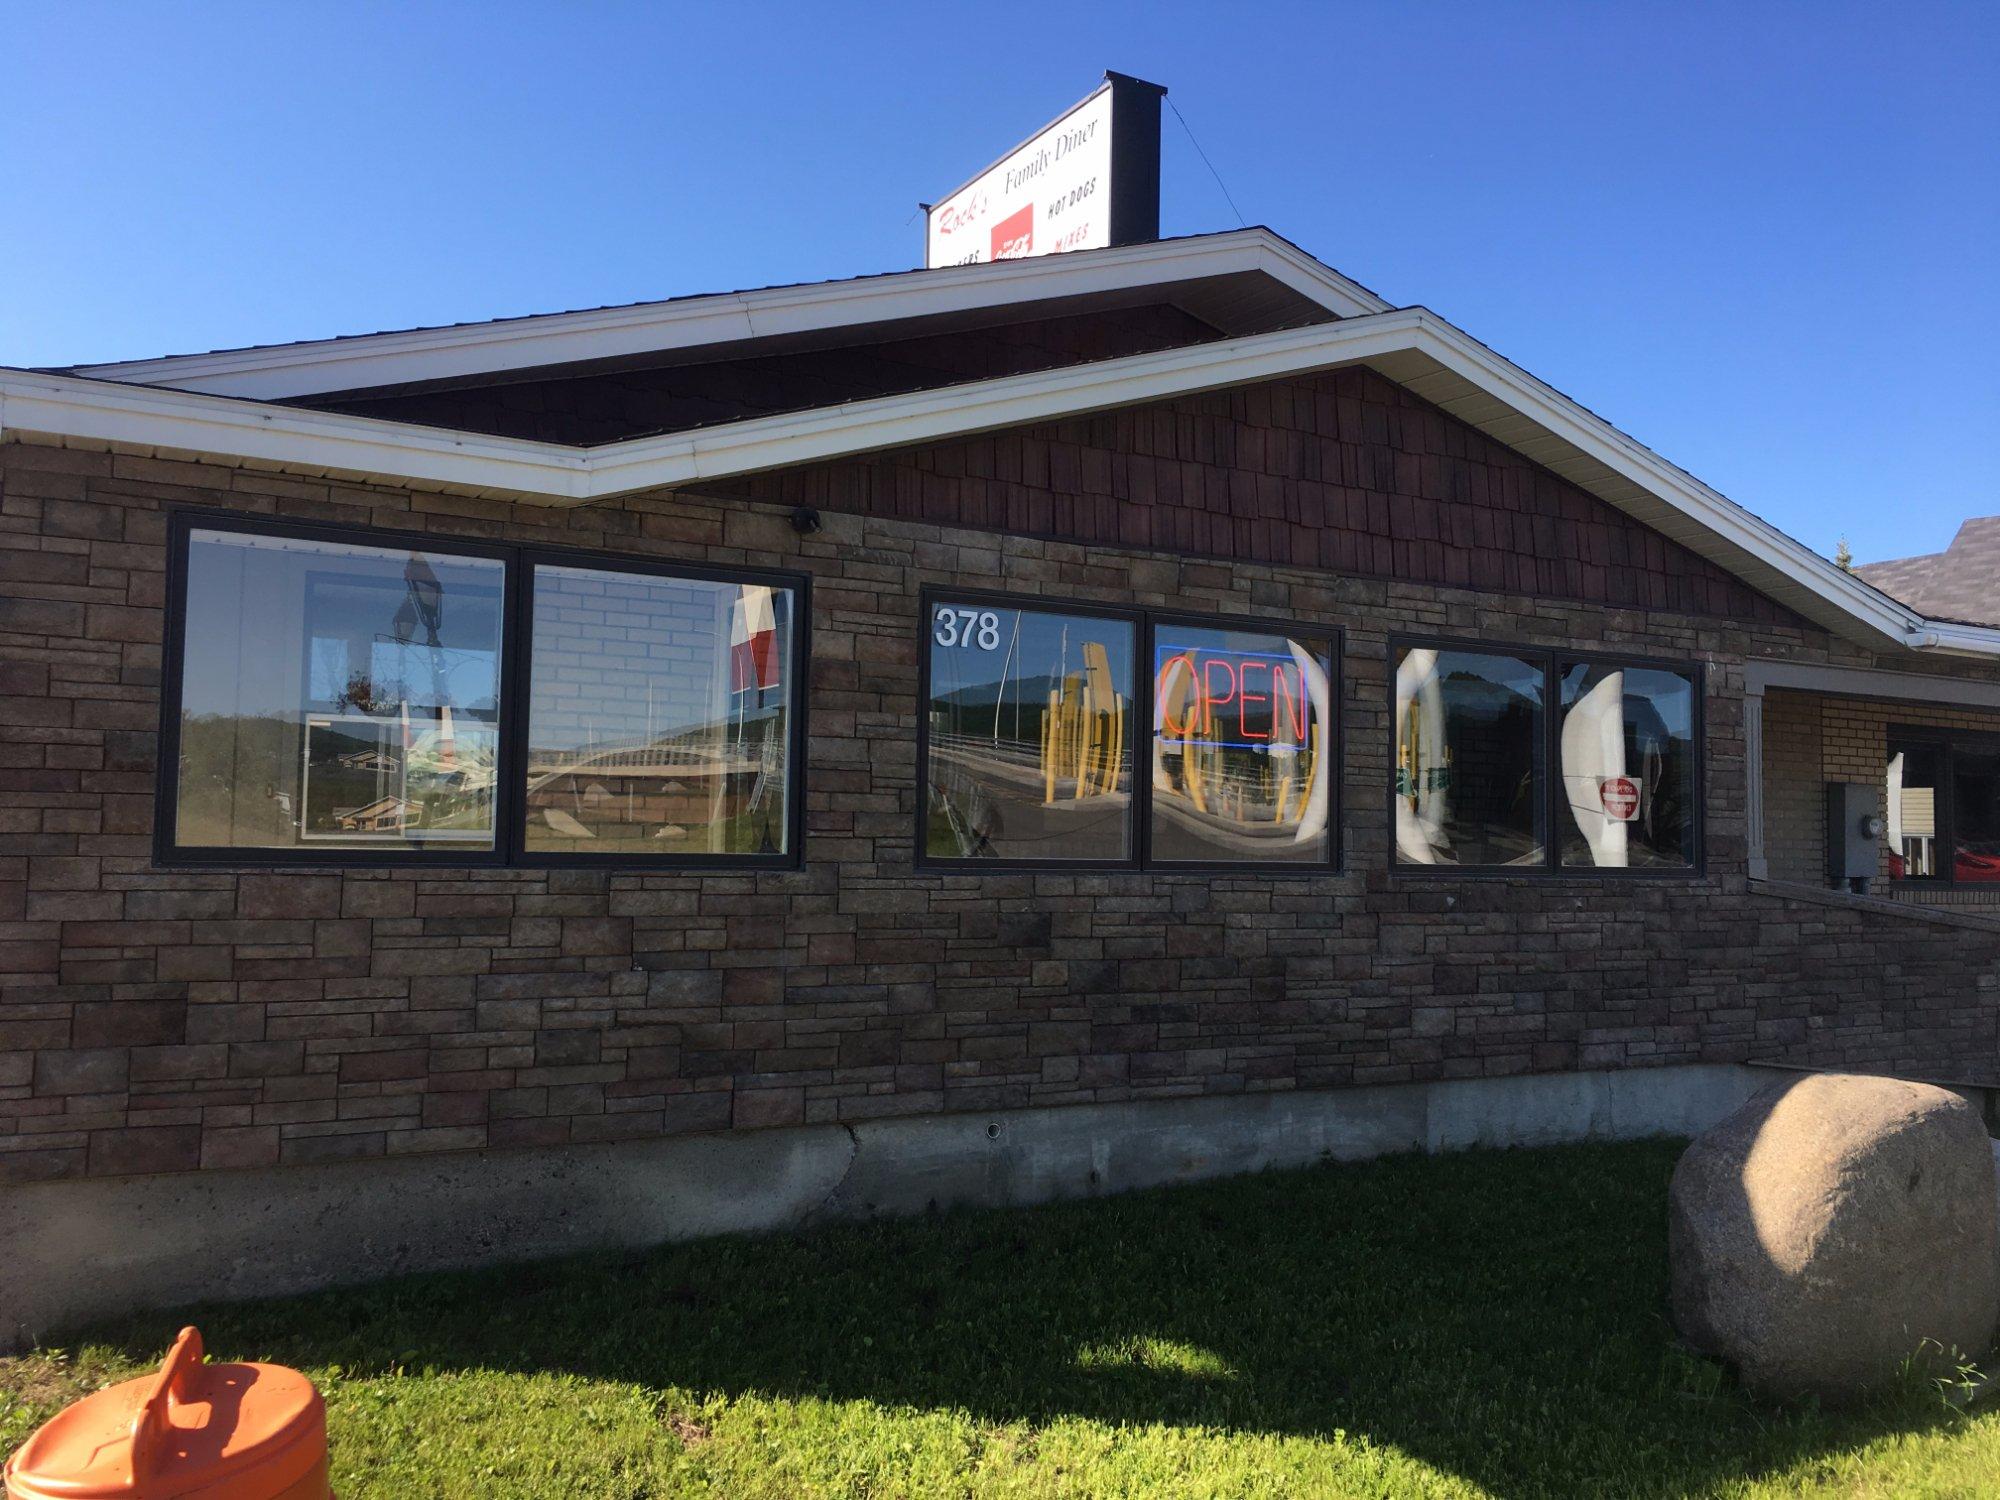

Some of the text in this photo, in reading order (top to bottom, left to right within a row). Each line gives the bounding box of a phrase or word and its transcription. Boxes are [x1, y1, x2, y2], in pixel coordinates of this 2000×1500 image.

[939, 119, 1098, 235] Rock's Family Diner
[1048, 176, 1097, 220] HOT DOGS
[935, 608, 1000, 651] 378
[1160, 655, 1305, 740] OPEN
